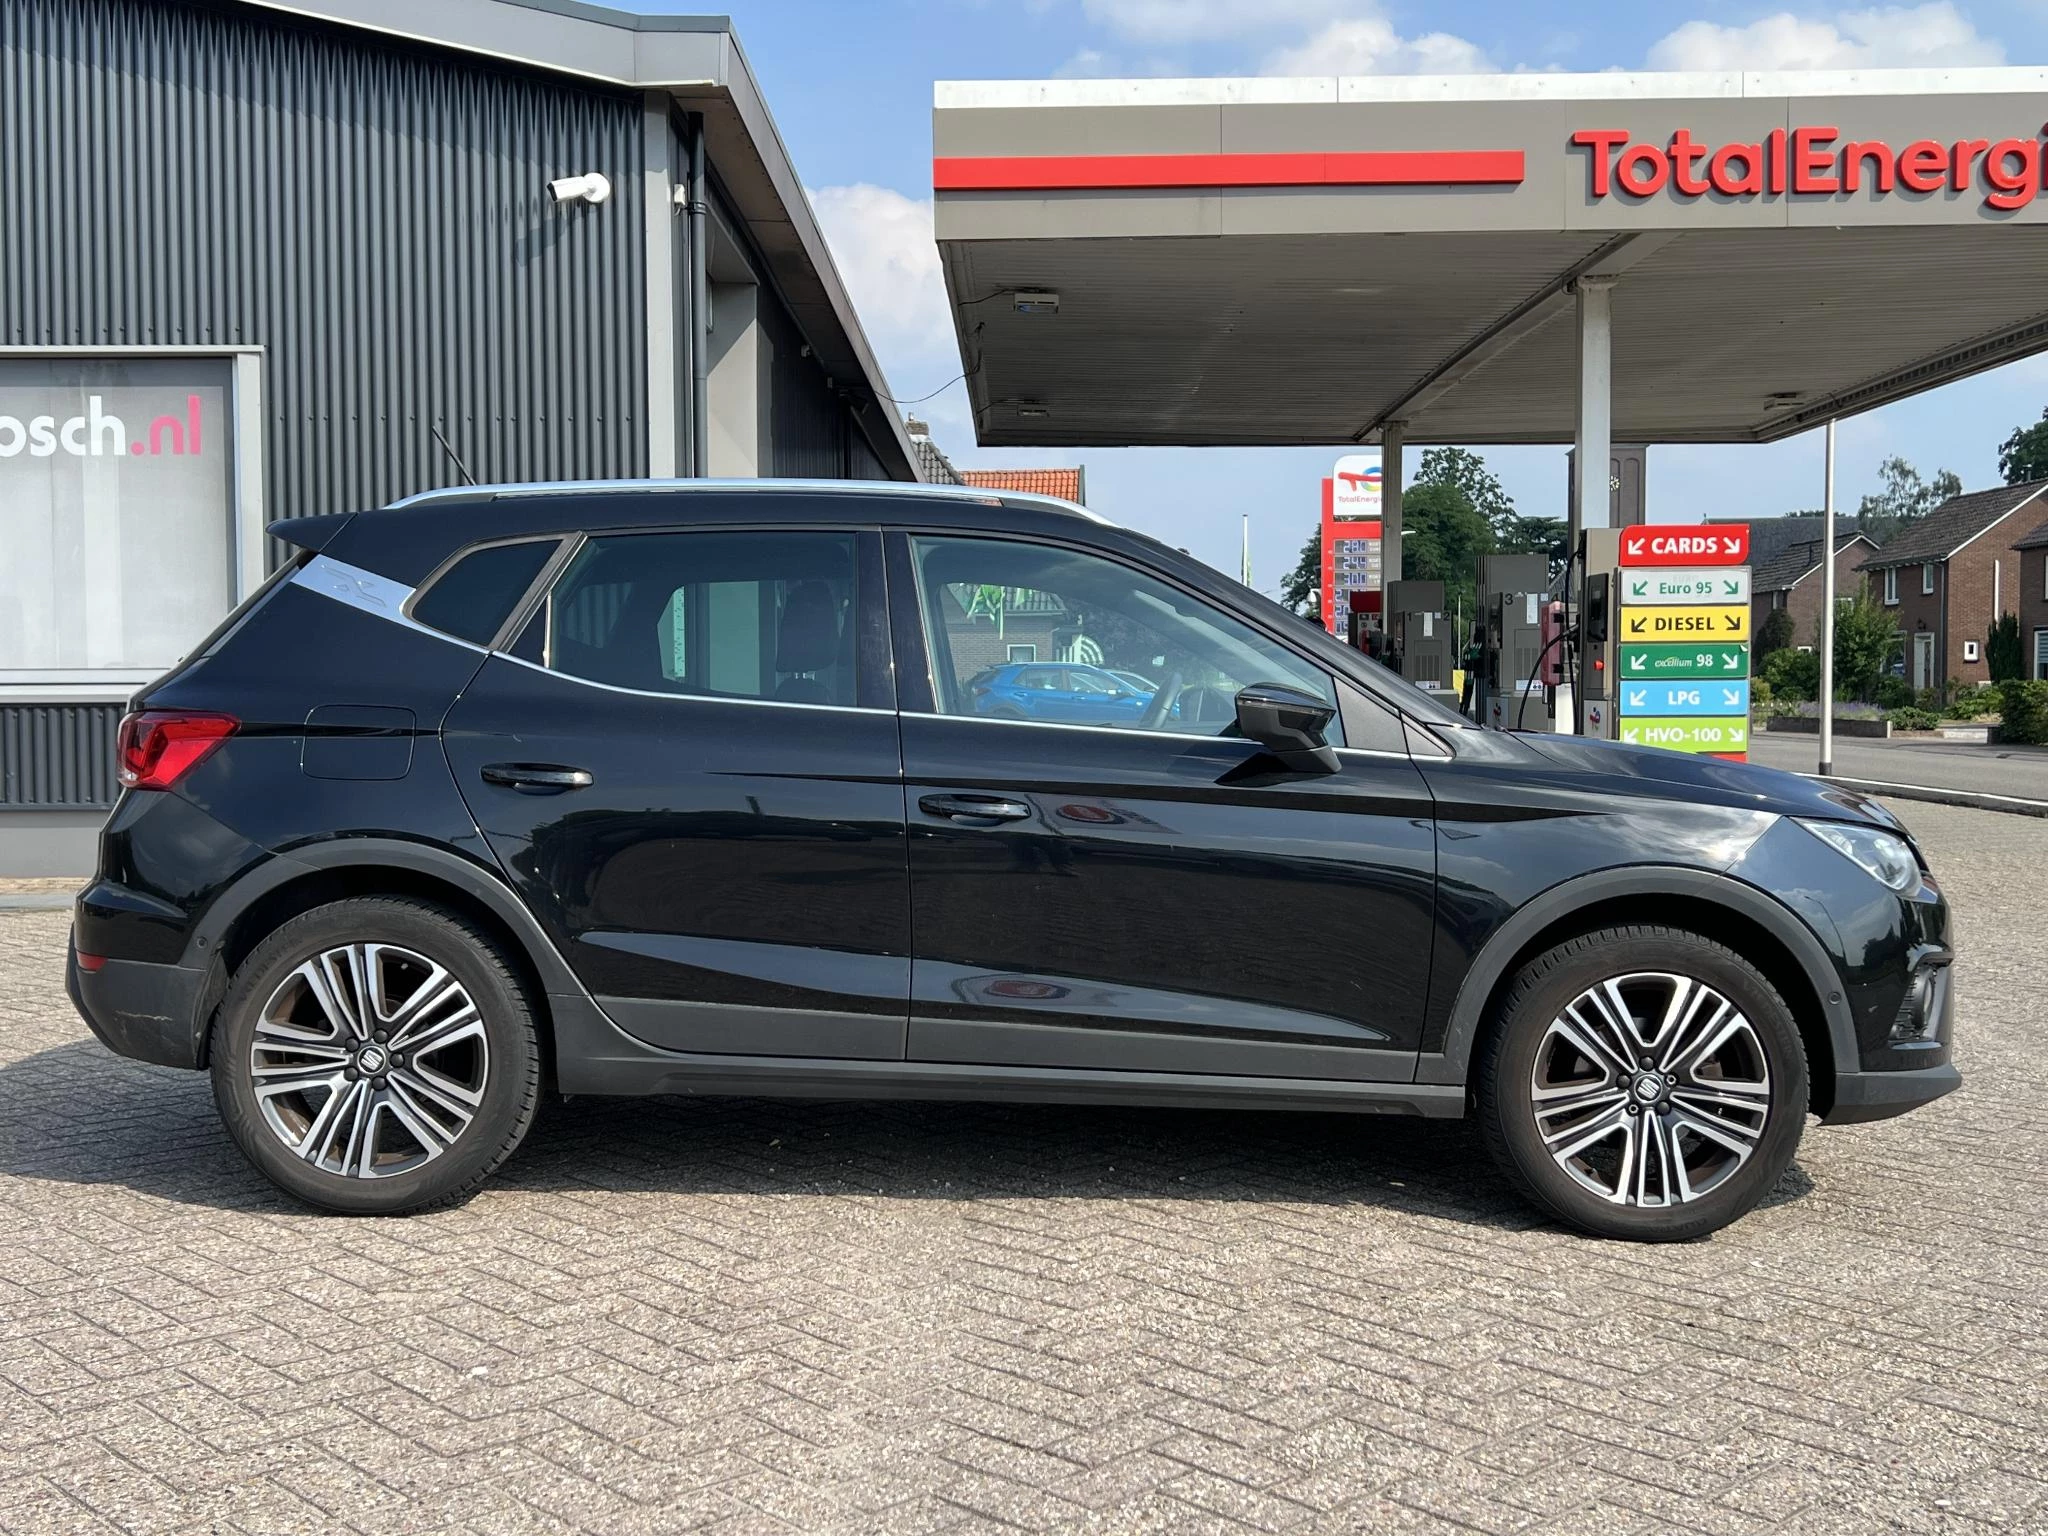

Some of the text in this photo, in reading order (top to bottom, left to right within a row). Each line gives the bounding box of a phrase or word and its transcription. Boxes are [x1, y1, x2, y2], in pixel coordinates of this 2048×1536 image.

[0, 394, 202, 458] osch.nl
[1338, 495, 1382, 504] TotalEnergi
[1651, 537, 1718, 555] CARDS
[1659, 582, 1712, 595] Euro 95
[1504, 593, 1514, 606] 3
[1655, 617, 1715, 631] DIESEL
[1654, 654, 1714, 668] excellium 98
[1668, 690, 1701, 705] LPG
[1645, 727, 1722, 742] HVO-100
